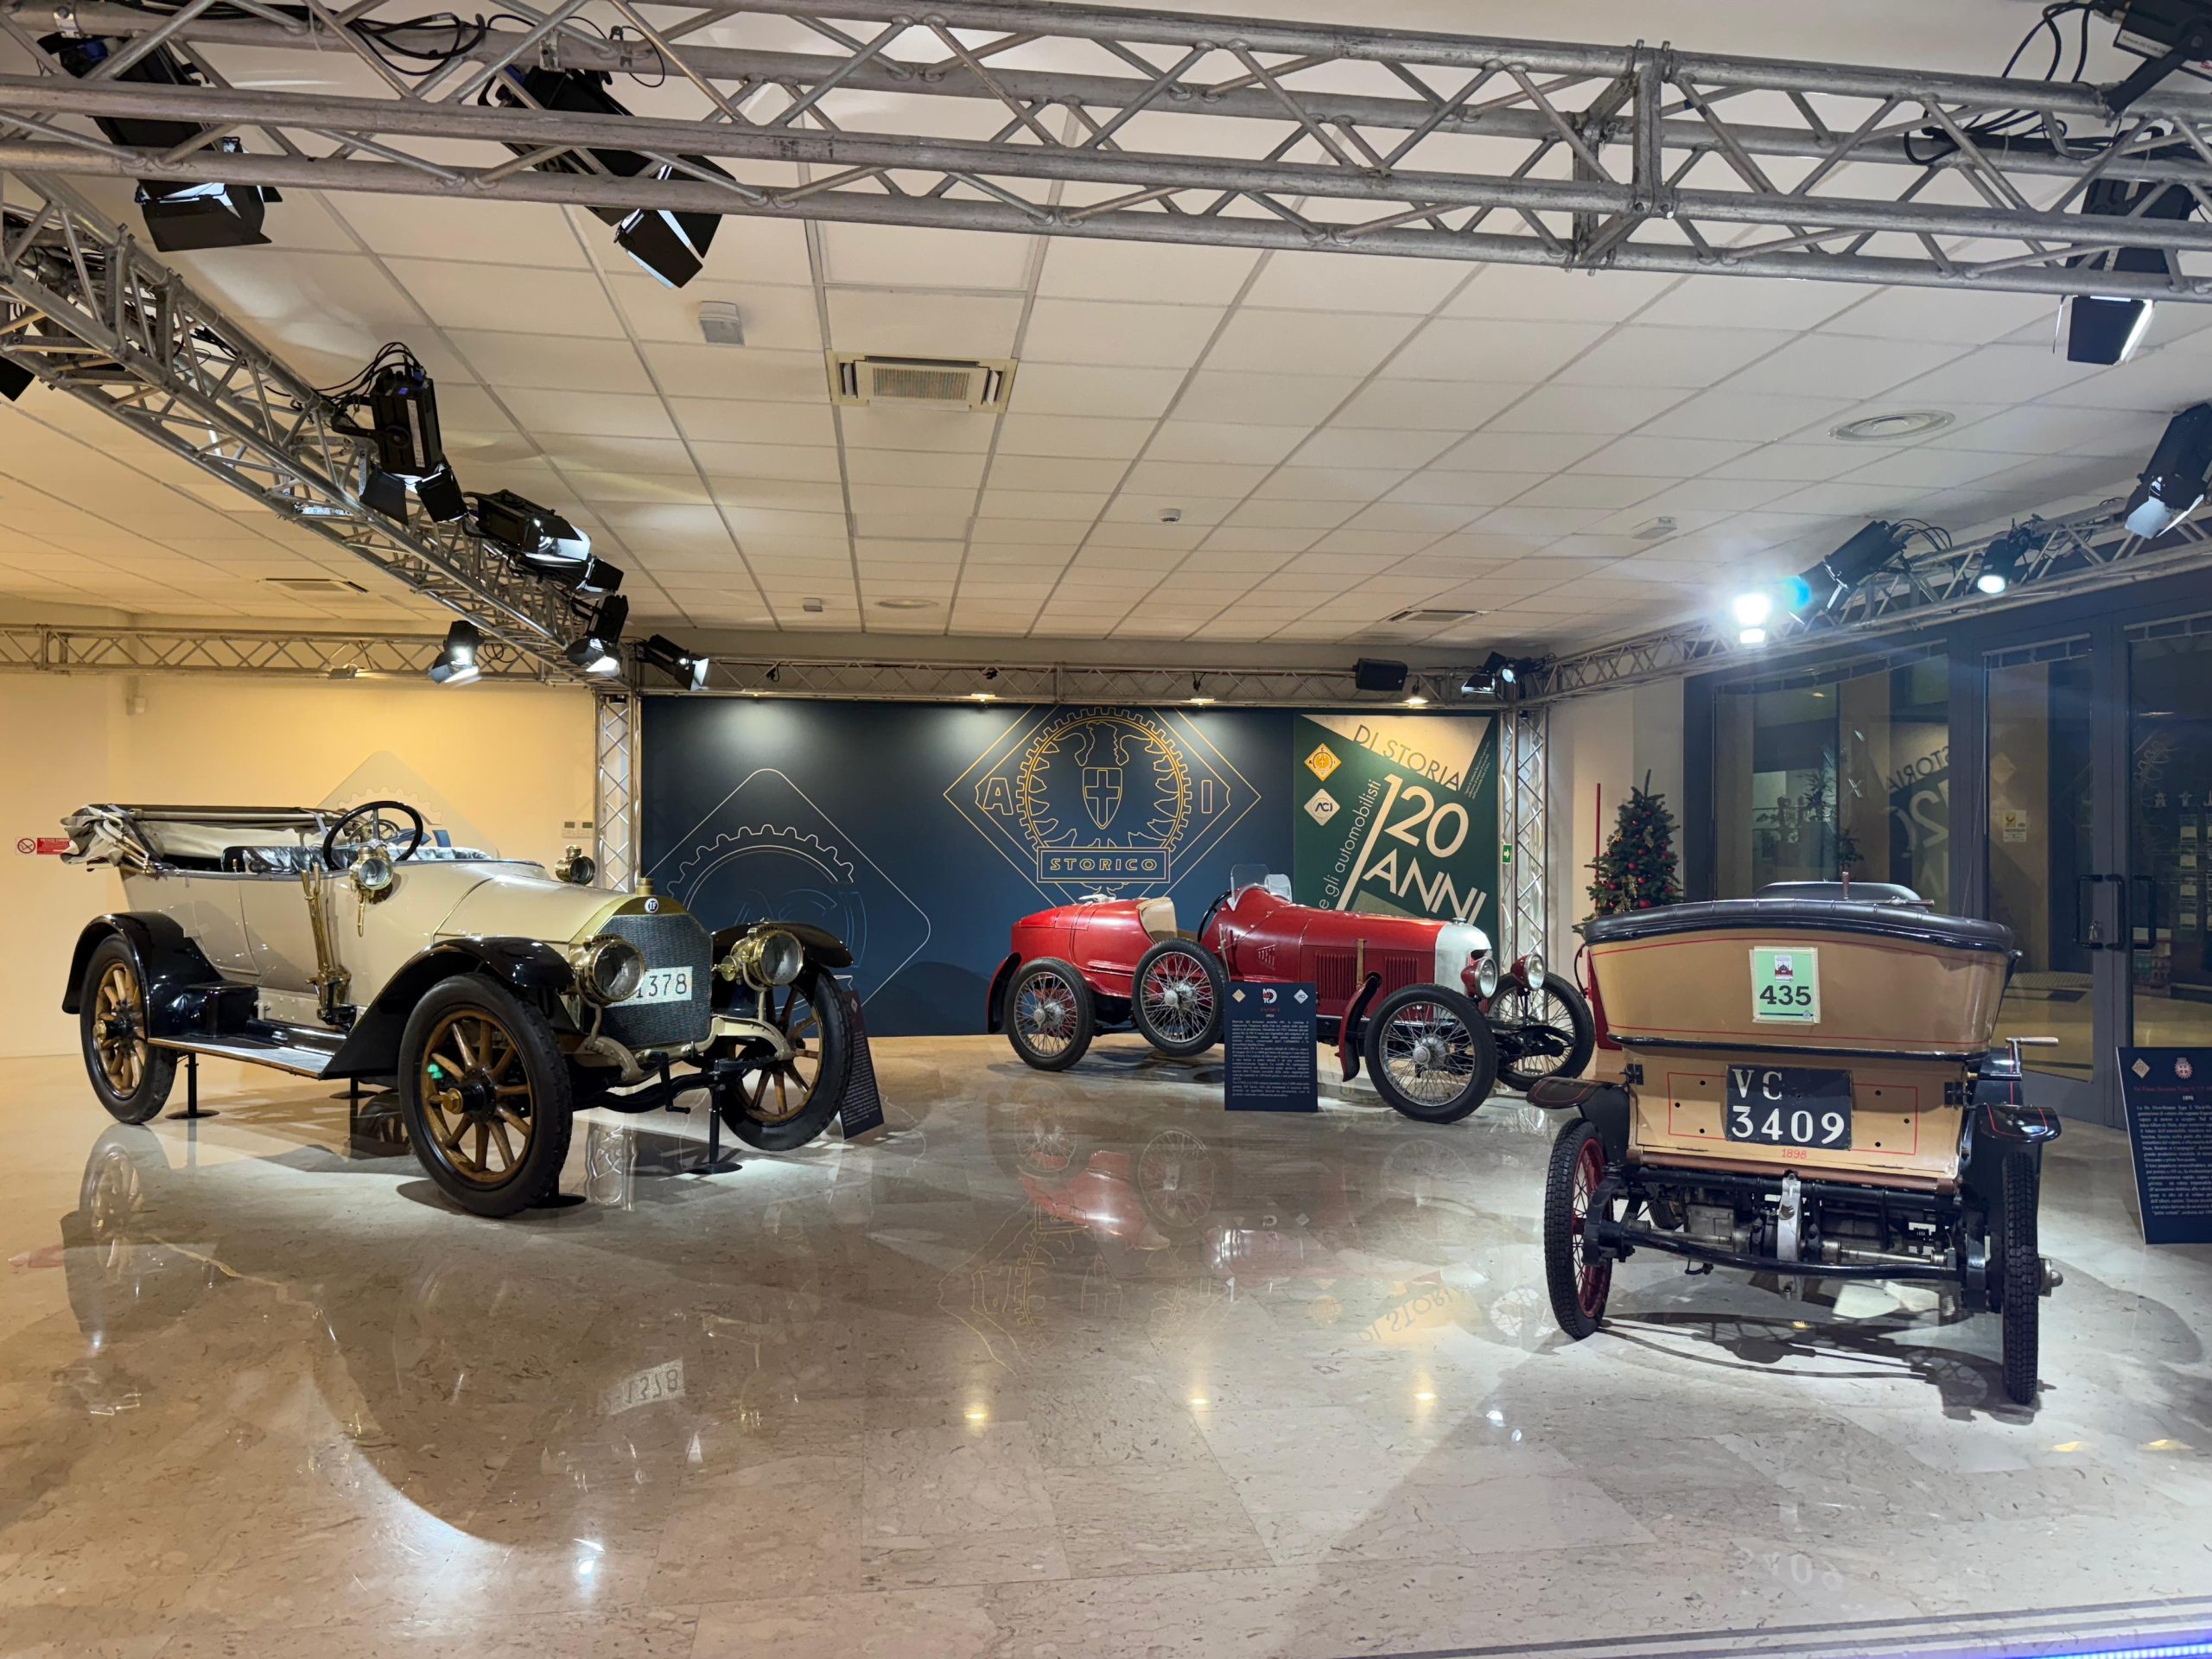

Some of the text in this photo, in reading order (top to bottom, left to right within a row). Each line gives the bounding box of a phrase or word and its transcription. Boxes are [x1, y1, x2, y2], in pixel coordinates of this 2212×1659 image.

[1353, 724, 1379, 750] DI
[1382, 740, 1460, 791] STORIA
[983, 778, 1014, 815] A
[1314, 802, 1333, 812] ACI
[1319, 779, 1382, 909] e gli automobilisti
[1050, 858, 1158, 871] STORICO
[1362, 848, 1487, 926] ANNI
[1759, 984, 1812, 1006] 435
[1732, 1069, 1783, 1101] VC
[1732, 1105, 1845, 1145] 3409
[1782, 1148, 1808, 1160] 1898
